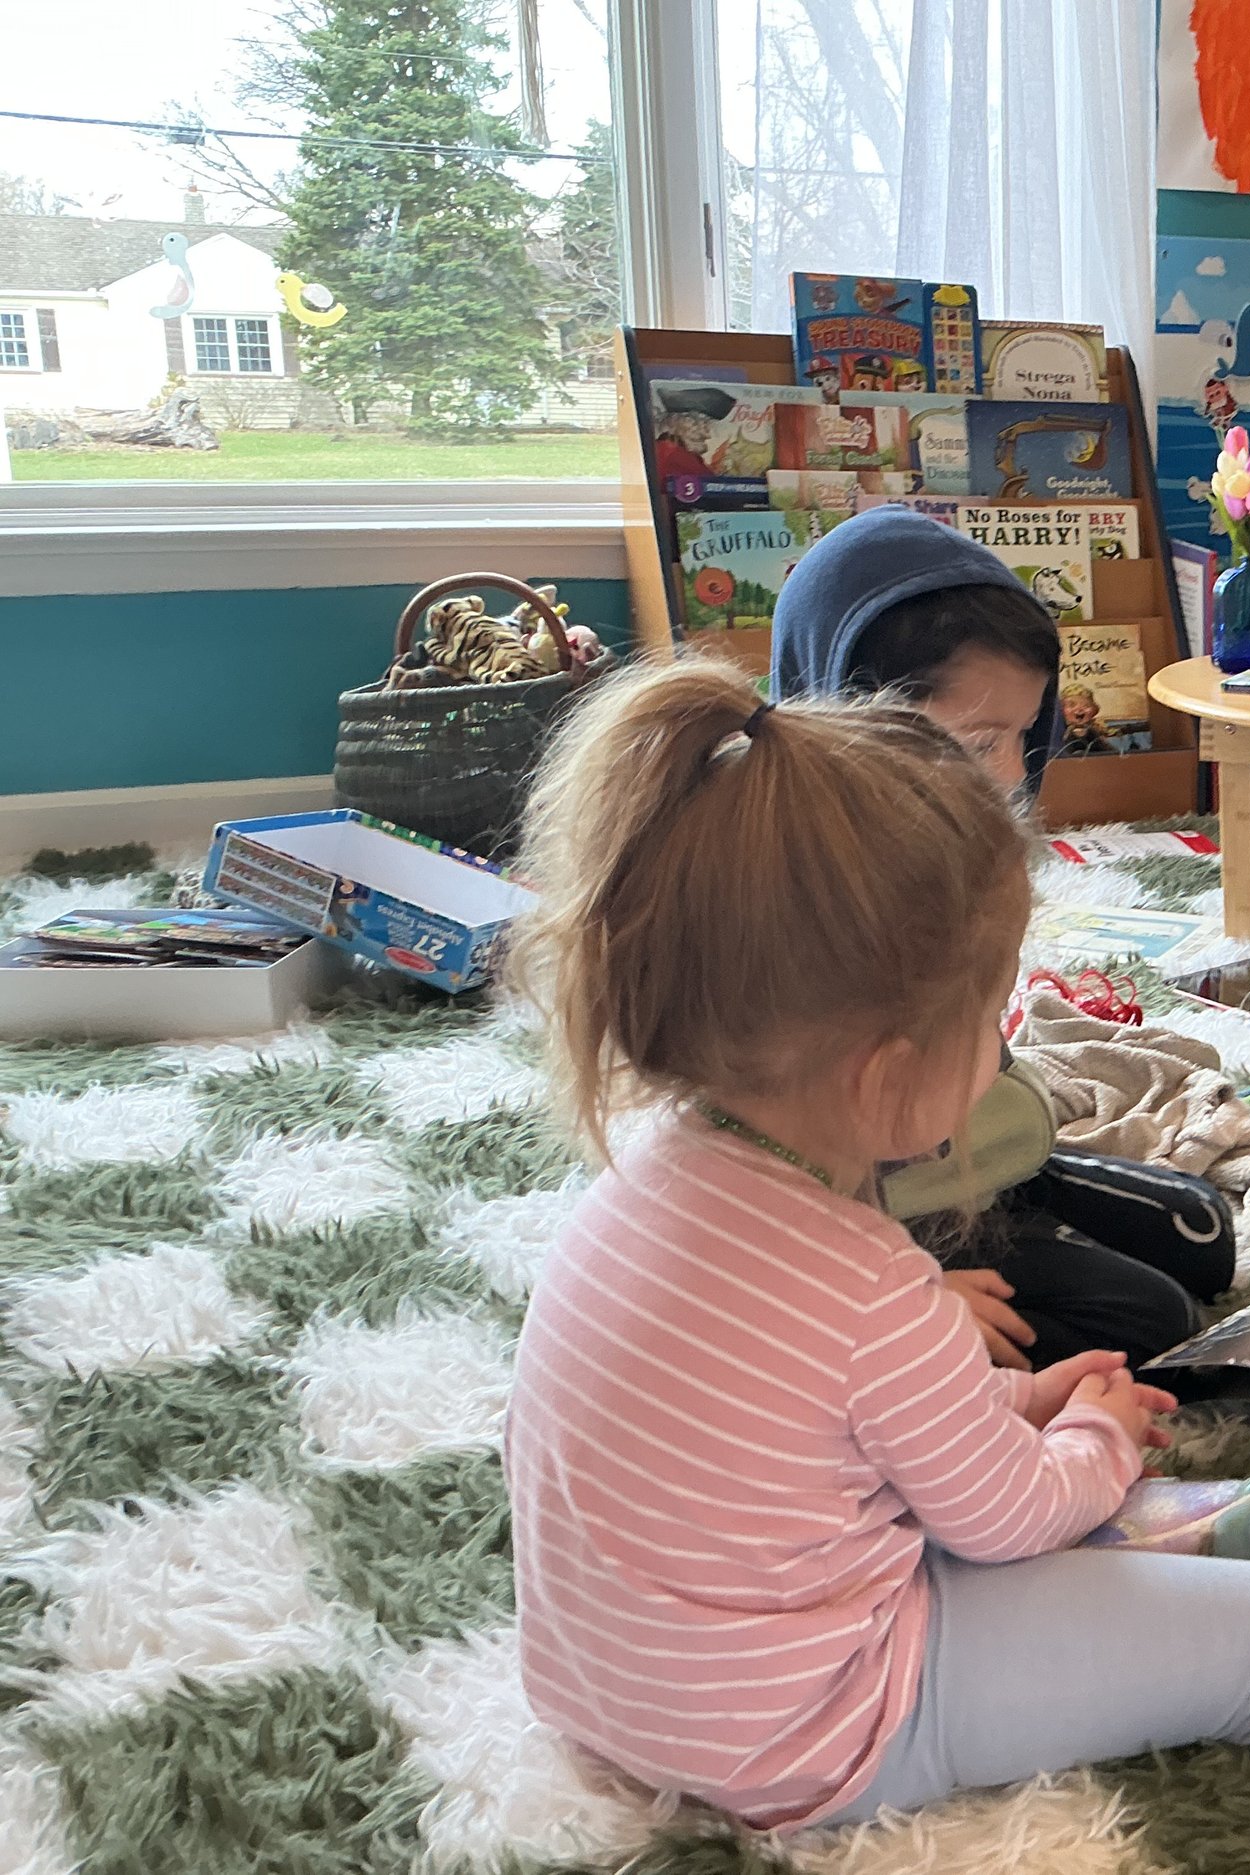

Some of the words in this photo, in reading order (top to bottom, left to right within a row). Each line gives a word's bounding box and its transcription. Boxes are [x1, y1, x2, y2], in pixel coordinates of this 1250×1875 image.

[809, 325, 922, 356] TREASURY
[1015, 368, 1077, 385] Strega
[1023, 386, 1071, 400] Nona
[684, 482, 695, 496] 3
[965, 509, 991, 523] No
[997, 509, 1050, 523] Roses
[1056, 507, 1081, 523] for
[1089, 512, 1126, 525] RRY
[969, 527, 1081, 545] HARRY!
[692, 530, 792, 561] GRUFFALO
[1067, 634, 1135, 657] Became
[412, 934, 447, 961] 27
